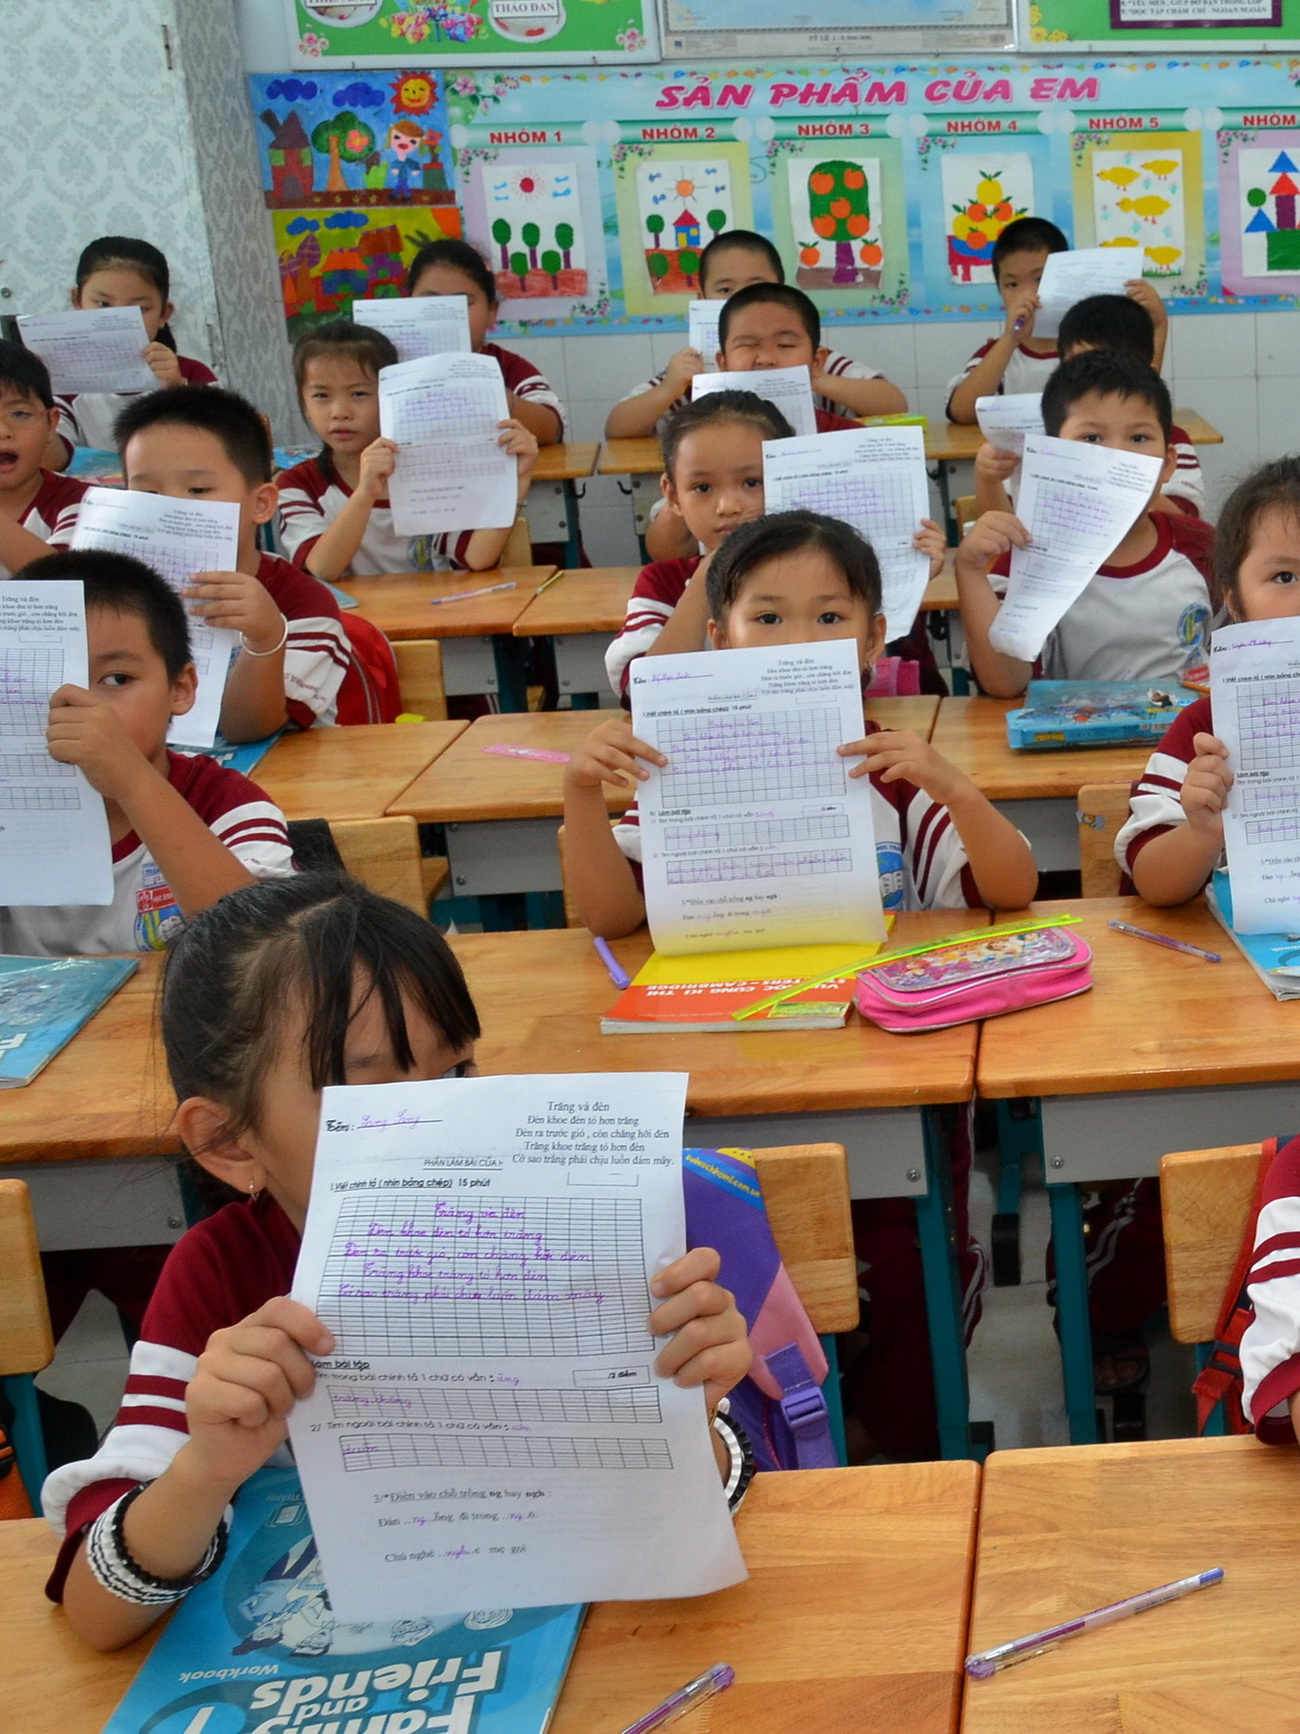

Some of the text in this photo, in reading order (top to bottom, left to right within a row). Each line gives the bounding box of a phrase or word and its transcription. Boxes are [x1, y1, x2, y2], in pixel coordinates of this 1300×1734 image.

[656, 71, 1099, 110] SẢN PHẨM CỦA EM
[947, 117, 1017, 132] NHÓM 4
[1089, 113, 1159, 130] NHÓM 5
[1243, 111, 1297, 127] NHÓM
[490, 128, 561, 144] NHÓM 1
[642, 124, 715, 141] NHÓM 2
[797, 121, 870, 136] NHÓM 3
[647, 981, 743, 989] CAMBRIDGE
[548, 1101, 610, 1113] Trăng và đèn
[528, 1114, 639, 1126] Đèn khoe đèn tỏ hơn trăng
[516, 1128, 533, 1138] Đèn
[546, 1128, 568, 1138] trước
[570, 1129, 585, 1140] gió
[592, 1129, 608, 1138] còn
[610, 1129, 635, 1140] chăng
[653, 1128, 669, 1139] đèn
[525, 1141, 645, 1153] Trăng khoe trăng tỏ hơn đèn
[544, 1155, 566, 1166] trăng
[568, 1154, 588, 1166] phải
[589, 1155, 608, 1166] chịu
[632, 1156, 651, 1165] đám
[179, 1664, 278, 1684] Workbook
[250, 1650, 502, 1714] Friends
[304, 1695, 369, 1718] and
